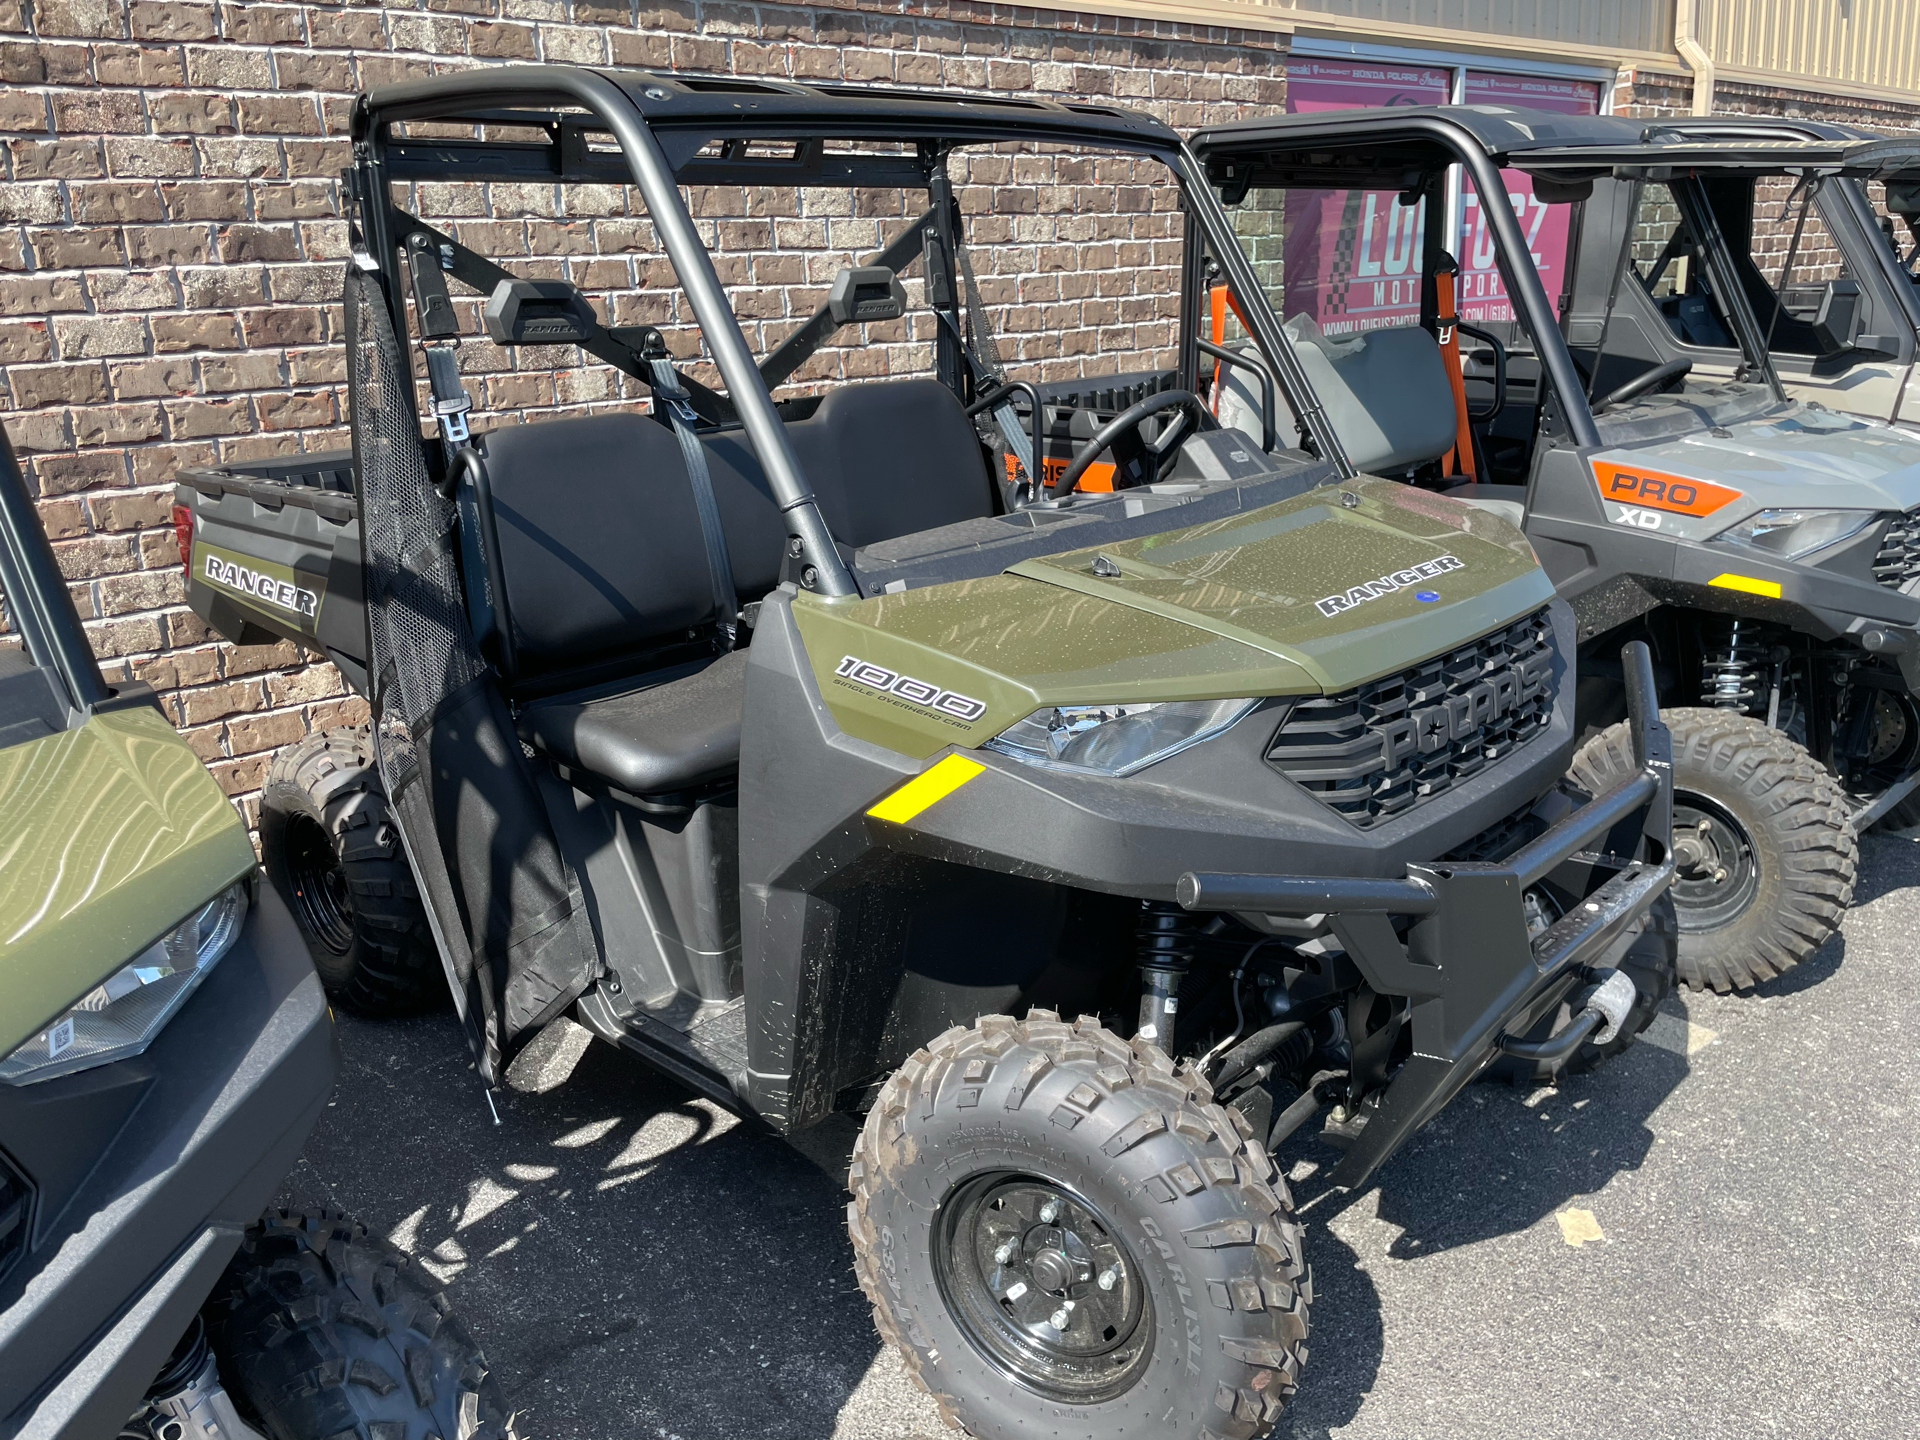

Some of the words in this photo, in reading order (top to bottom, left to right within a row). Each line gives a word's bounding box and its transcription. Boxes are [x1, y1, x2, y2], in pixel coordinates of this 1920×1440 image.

[1352, 69, 1385, 79] HONDA
[1387, 72, 1418, 82] POLARIS
[523, 325, 578, 334] RANGER
[1610, 473, 1697, 505] PRO
[1615, 506, 1662, 530] XD
[205, 554, 317, 617] RANGER
[1315, 555, 1465, 617] RANGER
[832, 678, 875, 697] SINGLE
[877, 695, 942, 721] OVERHEAD
[942, 718, 972, 731] CAM
[834, 655, 987, 722] 1000
[1381, 653, 1546, 772] POLARIS
[1138, 1216, 1202, 1386] CARLISLE
